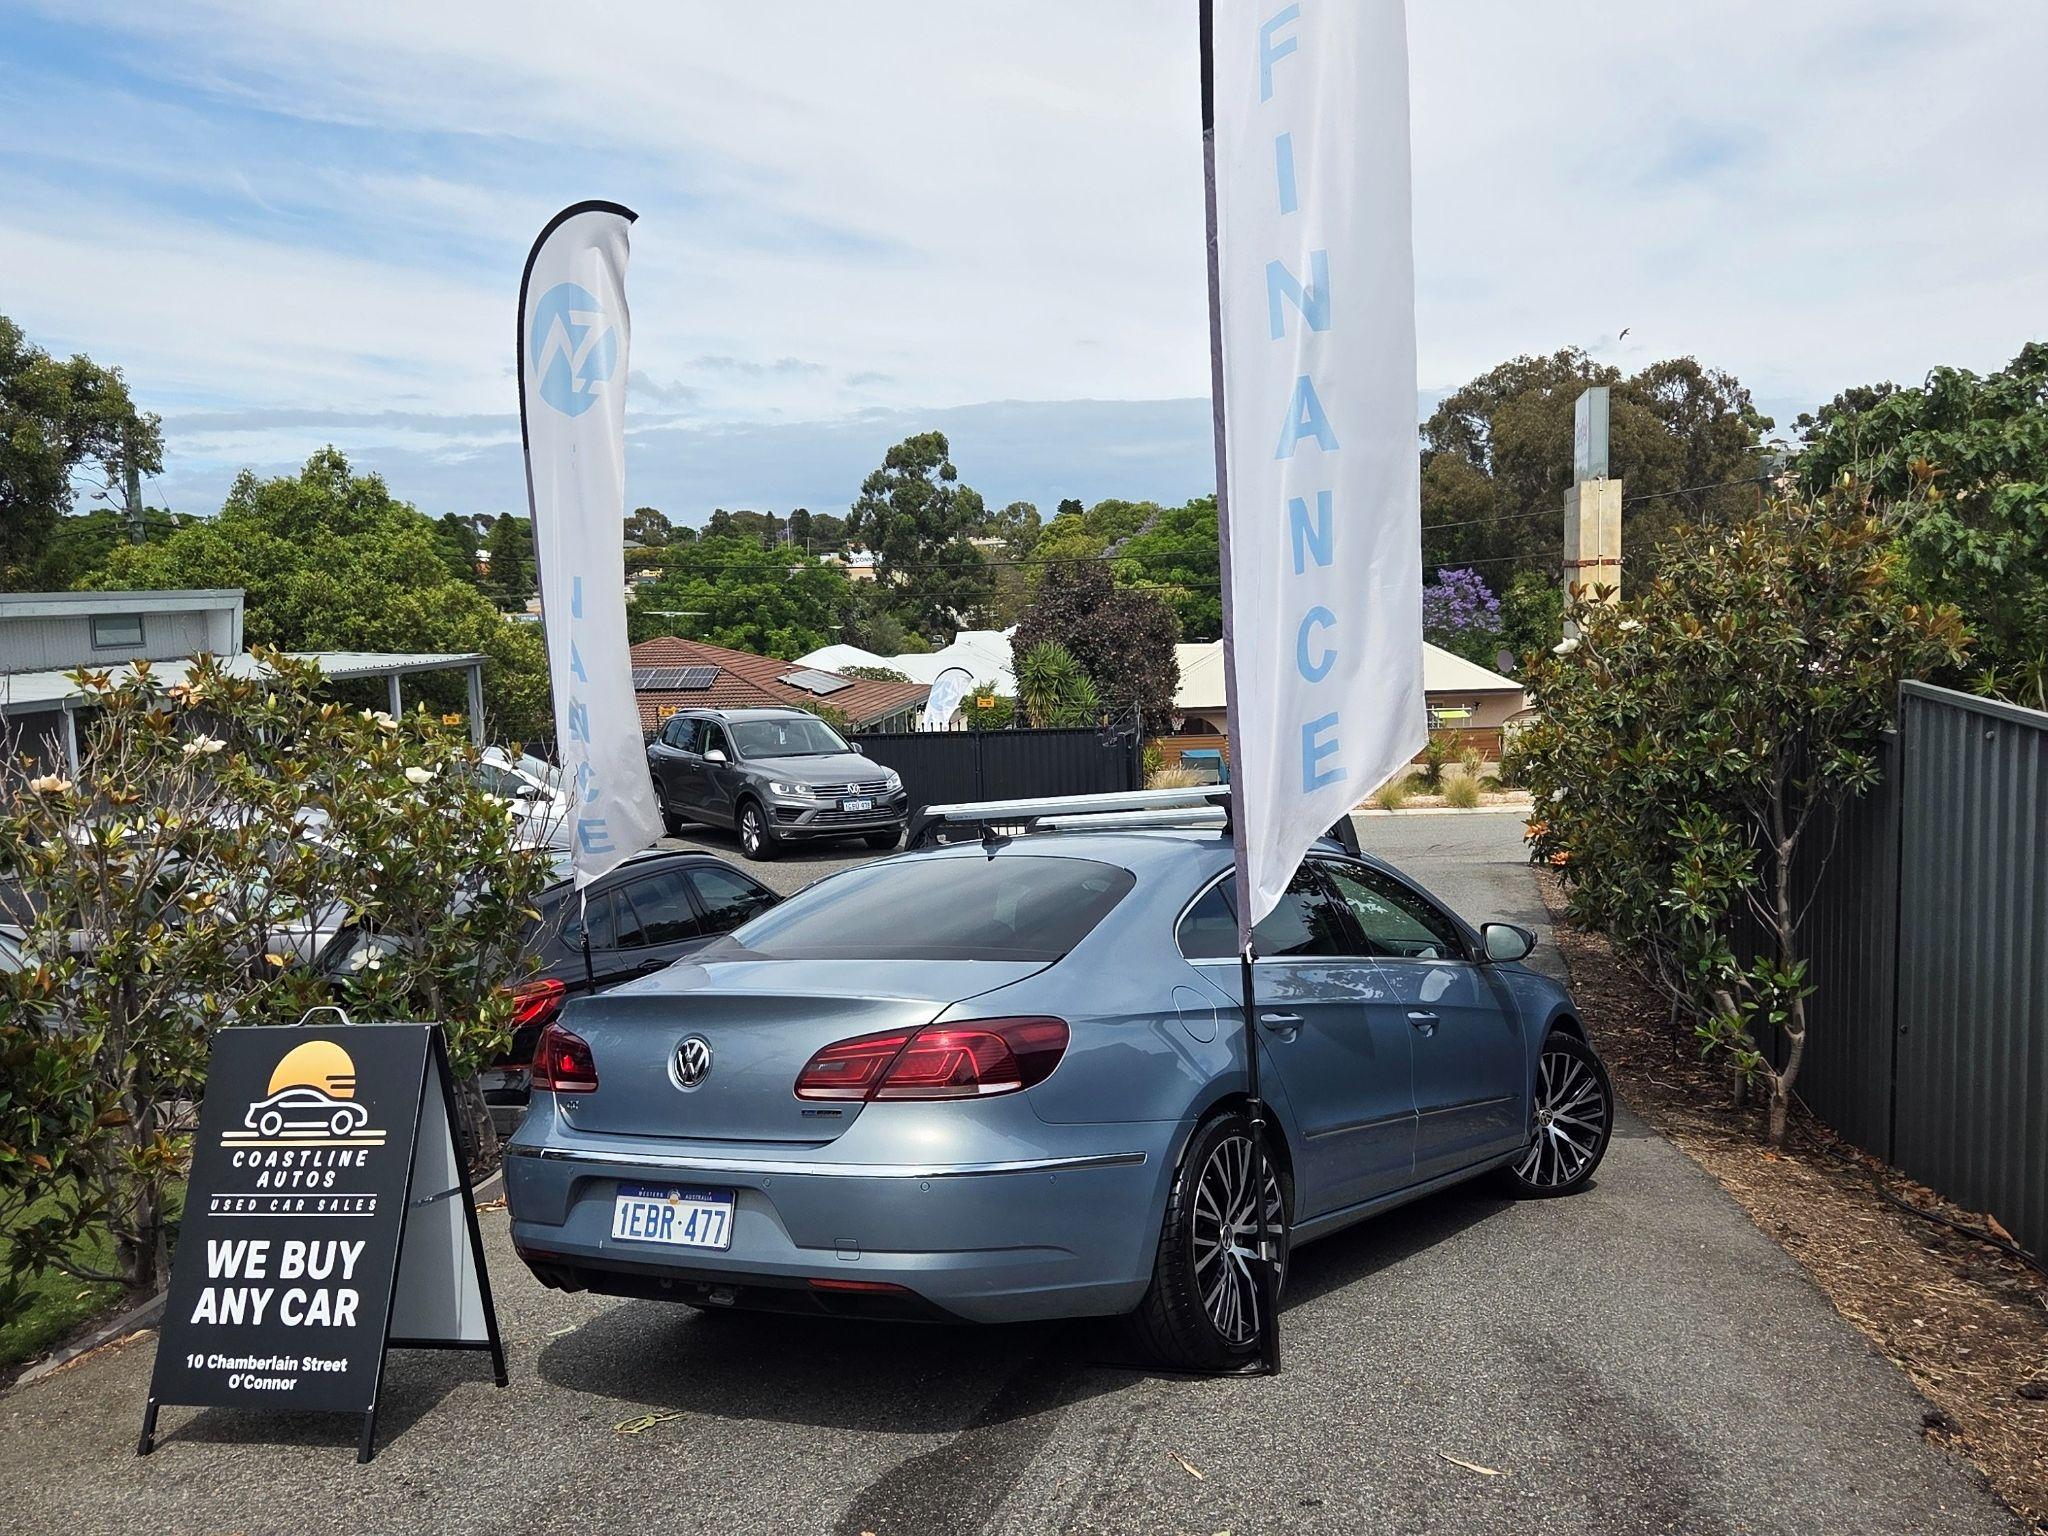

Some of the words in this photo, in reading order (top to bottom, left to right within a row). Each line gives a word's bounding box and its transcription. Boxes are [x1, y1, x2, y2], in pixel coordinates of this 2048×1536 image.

[1258, 2, 1348, 794] FINANCE
[232, 1150, 369, 1168] COASTLINE
[256, 1170, 336, 1188] AUTOS
[210, 1199, 257, 1211] USED
[270, 1199, 305, 1211] CAR
[317, 1199, 377, 1211] SALES
[684, 1193, 713, 1201] AUSTRALIA
[207, 1239, 271, 1279] WE
[279, 1240, 366, 1280] BUY
[190, 1287, 275, 1325] ANY
[279, 1288, 360, 1327] CAR
[186, 1354, 204, 1369] 10
[207, 1354, 298, 1371] Chamberlain
[302, 1356, 348, 1372] Street
[228, 1374, 297, 1390] O'Connor
